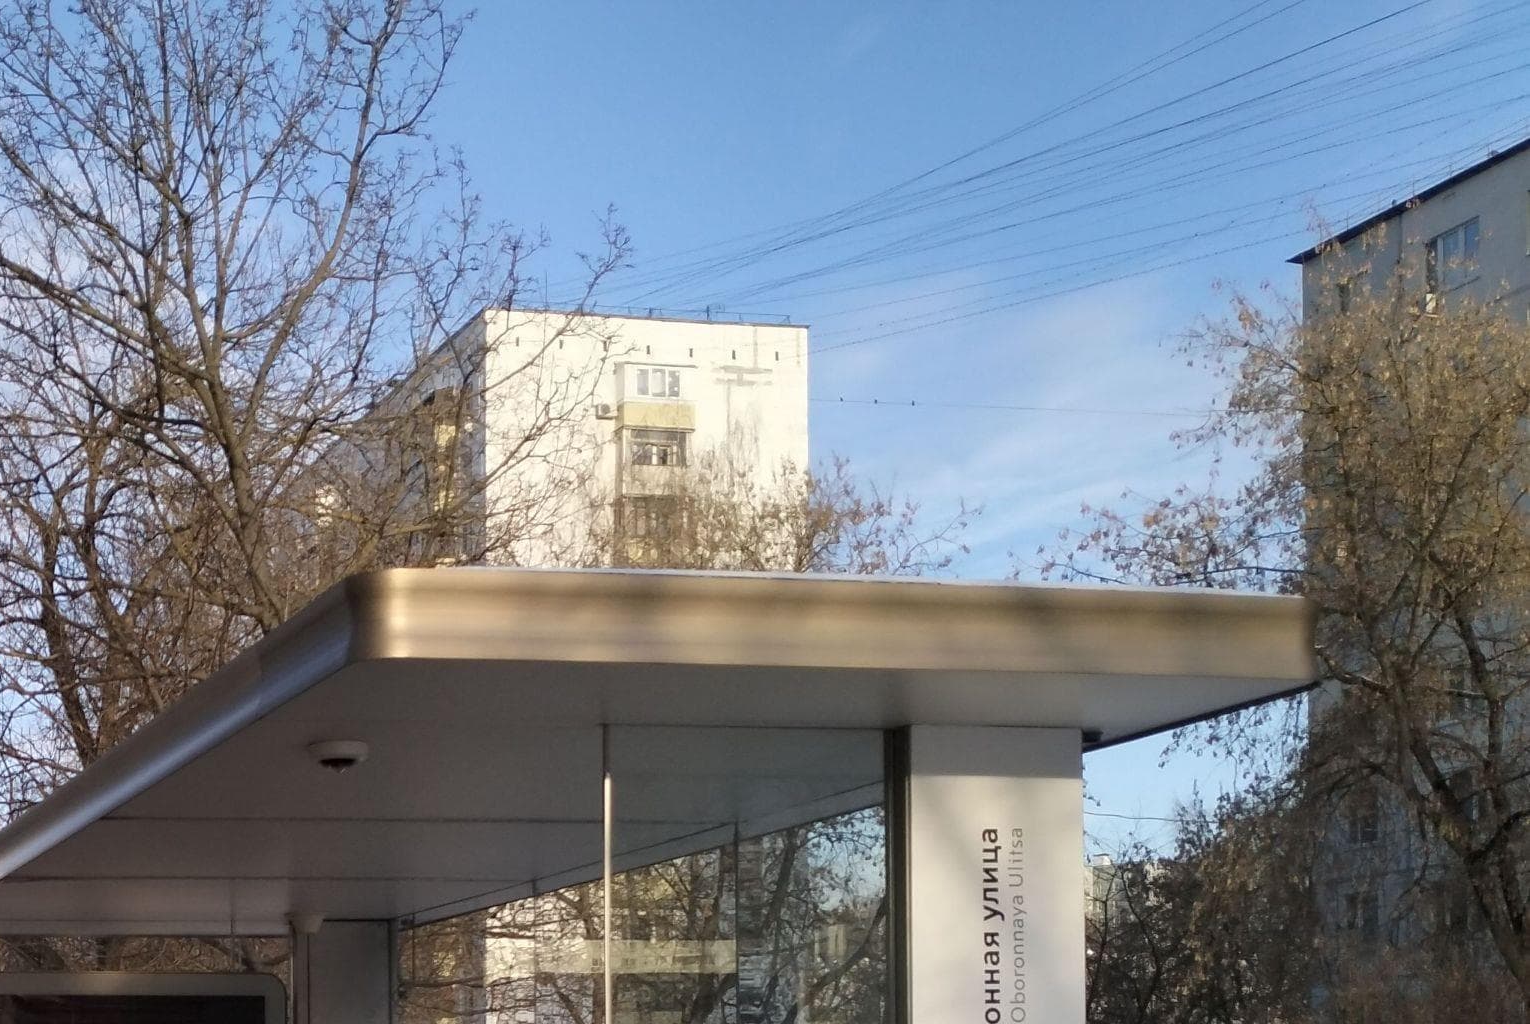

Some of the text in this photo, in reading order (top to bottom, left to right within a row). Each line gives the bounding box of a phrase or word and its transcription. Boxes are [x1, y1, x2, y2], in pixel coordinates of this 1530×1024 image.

[982, 827, 1005, 922] улица
[1009, 826, 1028, 1023] Oboronnaya Ulitsa
